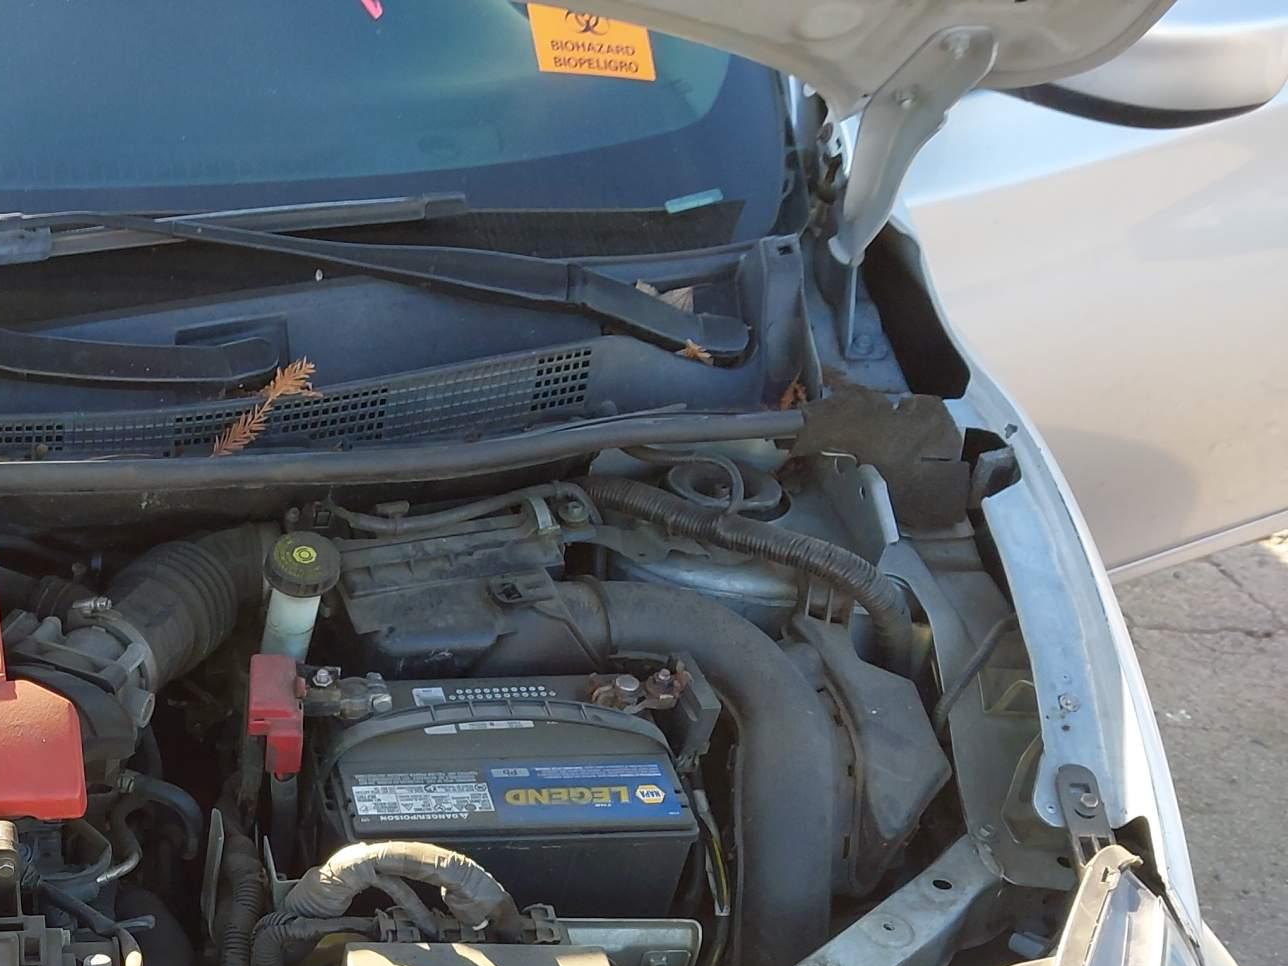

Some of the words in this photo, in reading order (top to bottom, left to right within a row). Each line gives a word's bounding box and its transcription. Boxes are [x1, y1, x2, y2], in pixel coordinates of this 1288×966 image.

[550, 40, 636, 56] BIOHAZARD
[553, 56, 639, 73] BIOPELIGRO
[505, 786, 630, 805] LEGEND
[639, 788, 661, 798] NAPA
